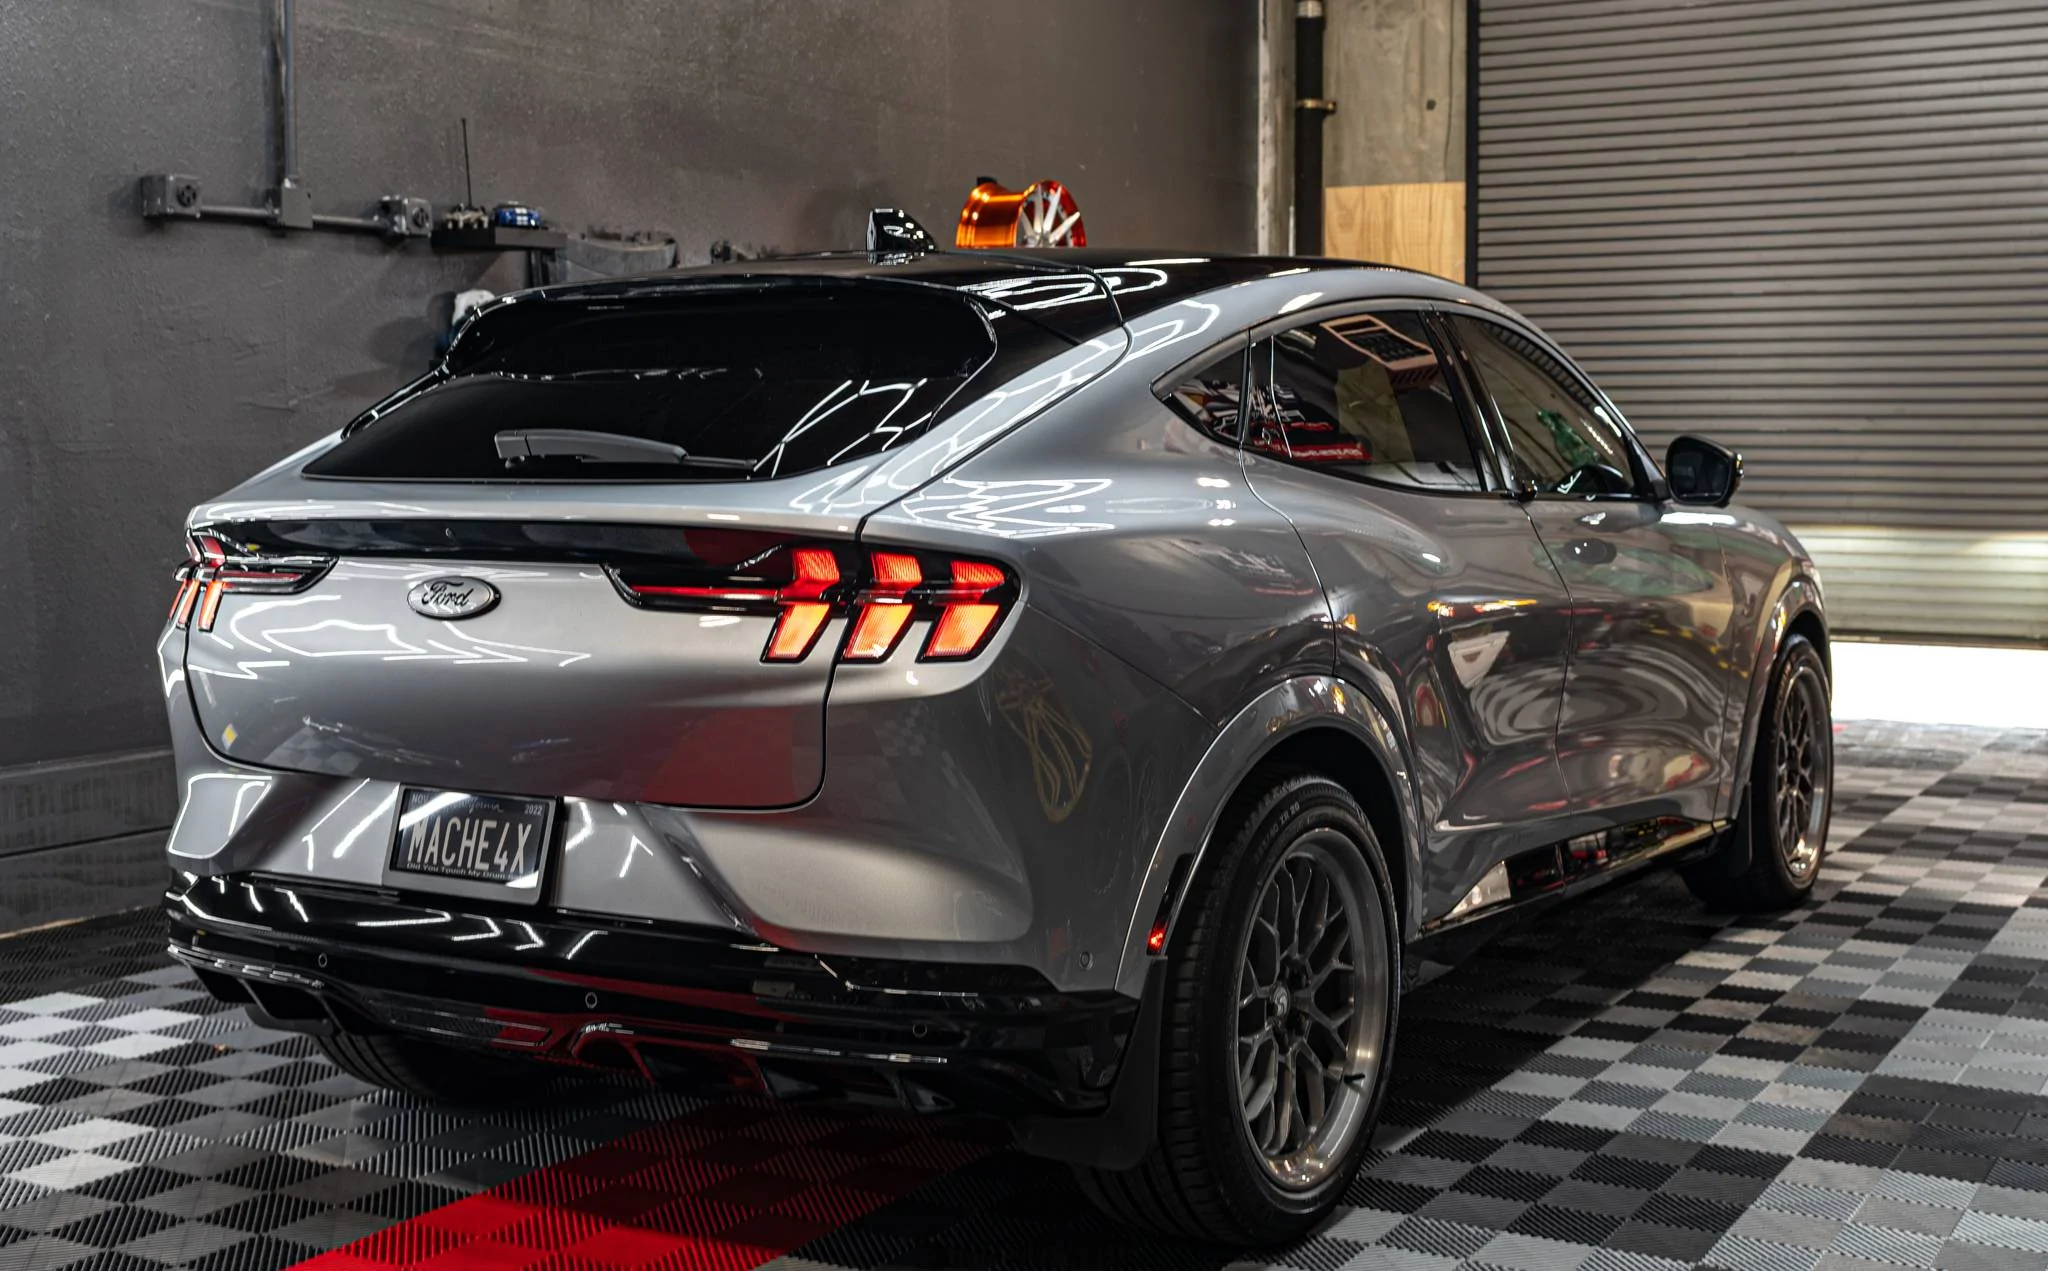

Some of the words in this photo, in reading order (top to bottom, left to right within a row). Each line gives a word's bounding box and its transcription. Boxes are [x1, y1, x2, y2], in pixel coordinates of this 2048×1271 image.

[422, 580, 474, 606] Ford
[524, 804, 543, 816] 2022
[1290, 801, 1300, 815] 20
[407, 815, 532, 874] MACHE4X
